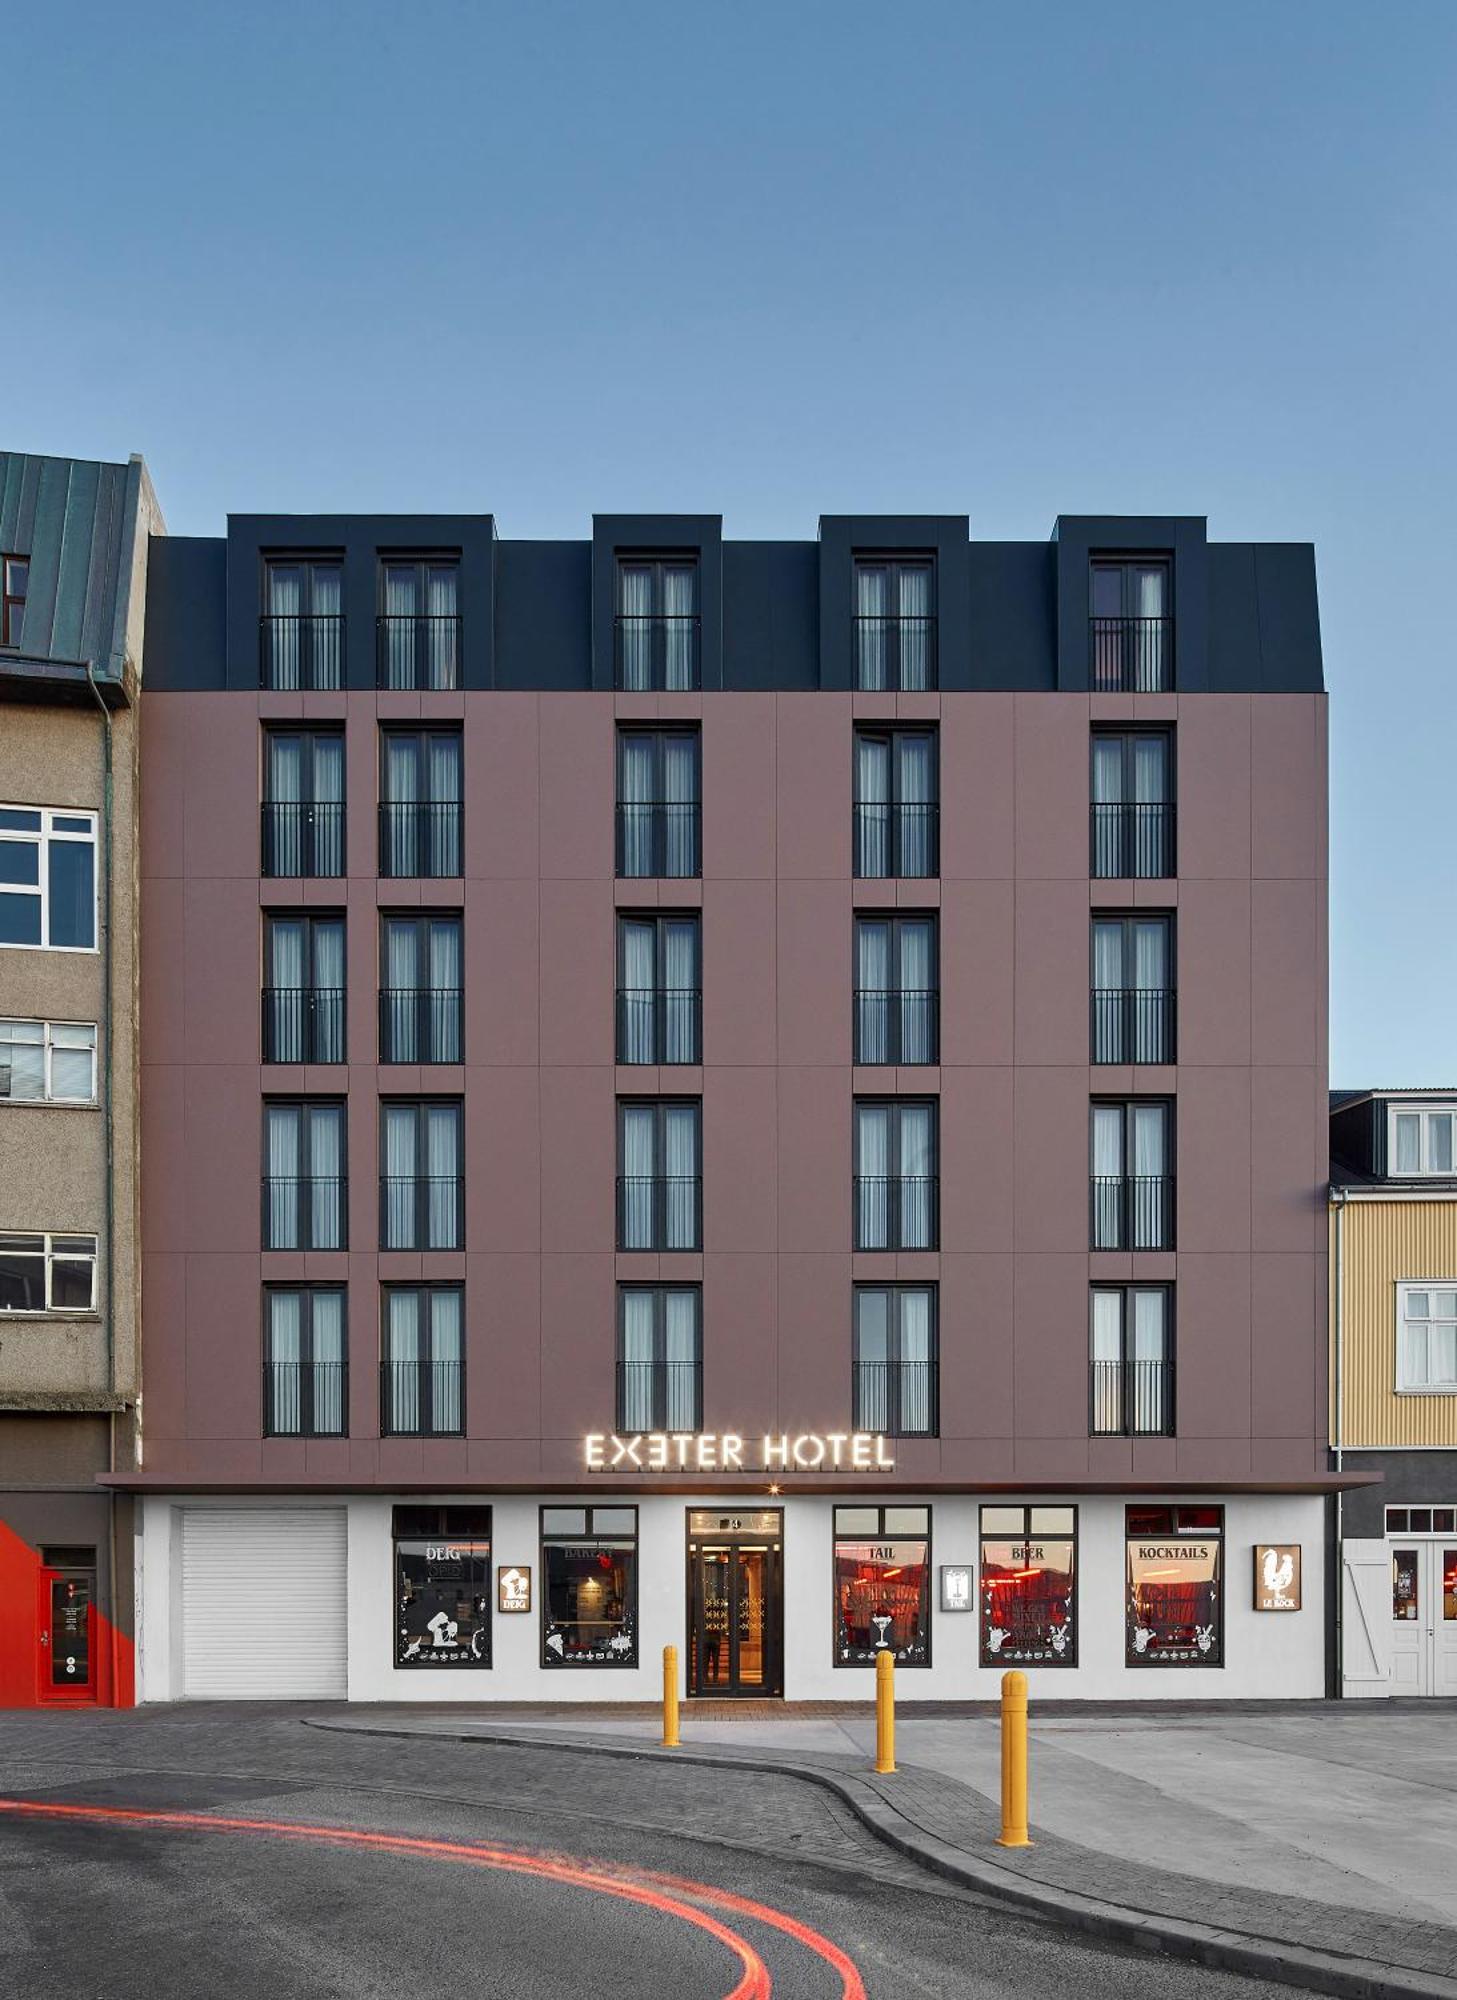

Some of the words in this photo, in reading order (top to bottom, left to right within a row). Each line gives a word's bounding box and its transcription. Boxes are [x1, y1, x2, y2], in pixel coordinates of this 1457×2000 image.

[764, 1435, 896, 1466] HOTEL
[425, 1547, 461, 1560] DEIG
[869, 1547, 896, 1559] TAIL
[1012, 1547, 1045, 1559] BEER
[1139, 1547, 1208, 1559] KOCKTAILS
